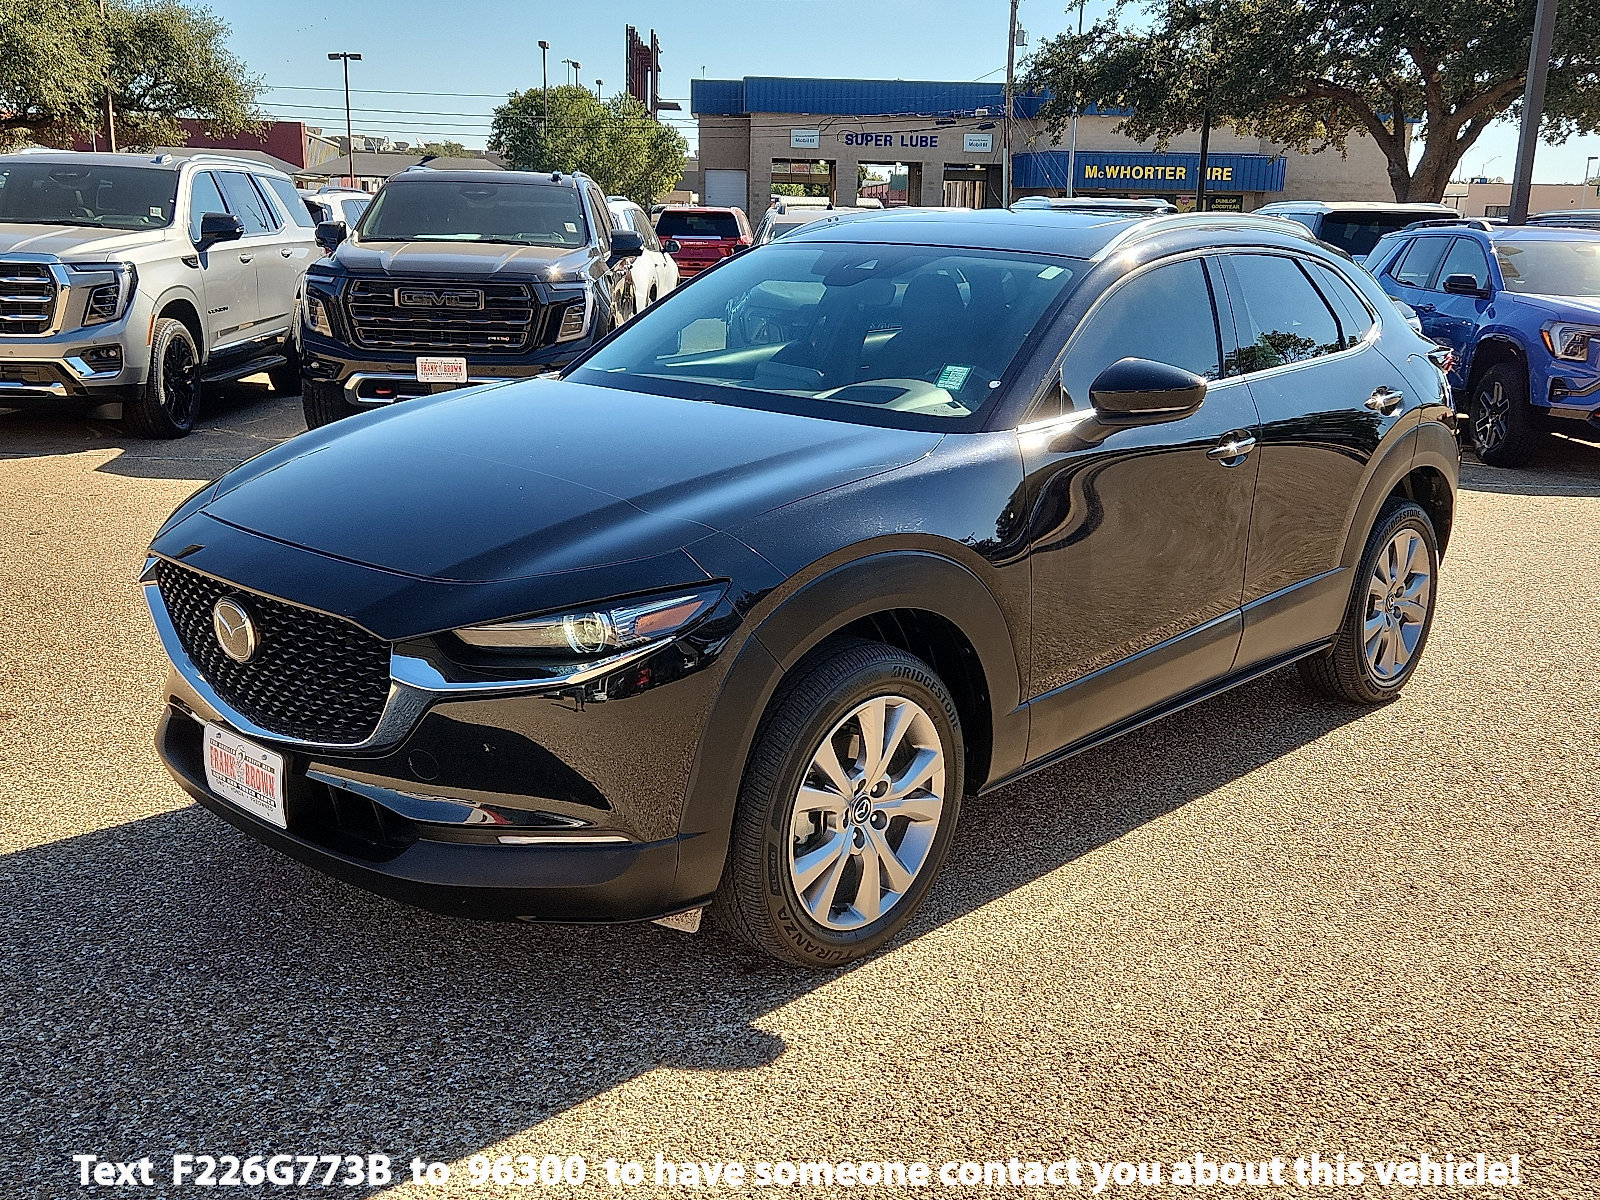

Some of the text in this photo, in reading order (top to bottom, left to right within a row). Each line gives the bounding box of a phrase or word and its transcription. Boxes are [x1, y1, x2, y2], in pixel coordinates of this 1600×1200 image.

[845, 134, 939, 148] SUPER LUBE
[1085, 165, 1233, 181] McWHORTER IRE
[400, 290, 478, 307] GMC
[891, 665, 959, 733] BRIDGESTONE
[209, 745, 236, 779] FRANK
[245, 762, 276, 799] BROWN
[777, 905, 854, 961] TURANZA
